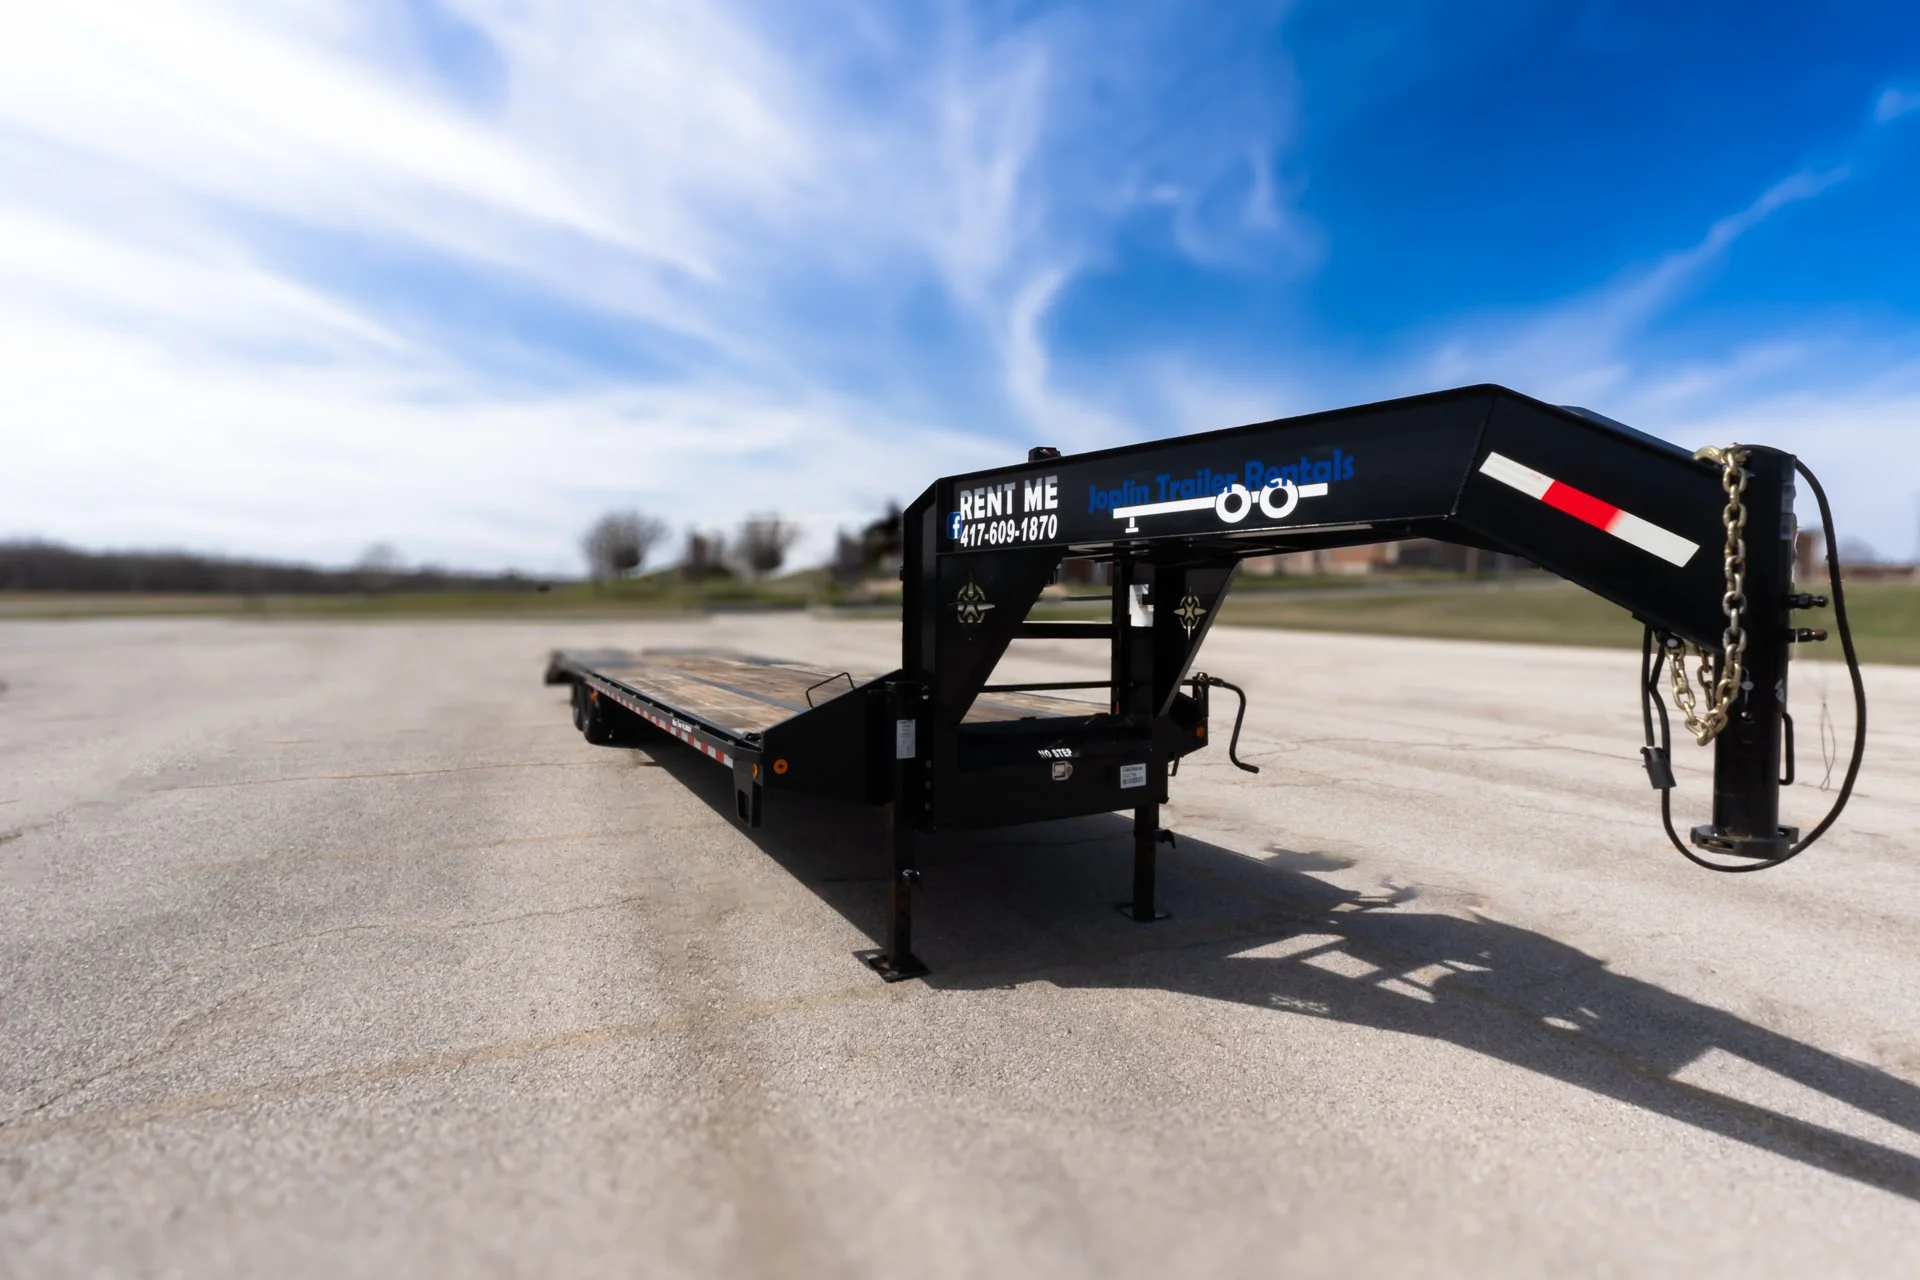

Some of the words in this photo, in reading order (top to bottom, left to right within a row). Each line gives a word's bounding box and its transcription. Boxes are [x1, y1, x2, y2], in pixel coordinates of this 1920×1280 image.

[960, 482, 1015, 520] RENT
[1024, 475, 1058, 512] ME
[1088, 480, 1149, 513] Joplin
[1156, 466, 1237, 500] Trailer
[1245, 448, 1355, 491] Rentals
[960, 514, 1058, 547] 417-609-1870
[1052, 748, 1072, 758] STEP
